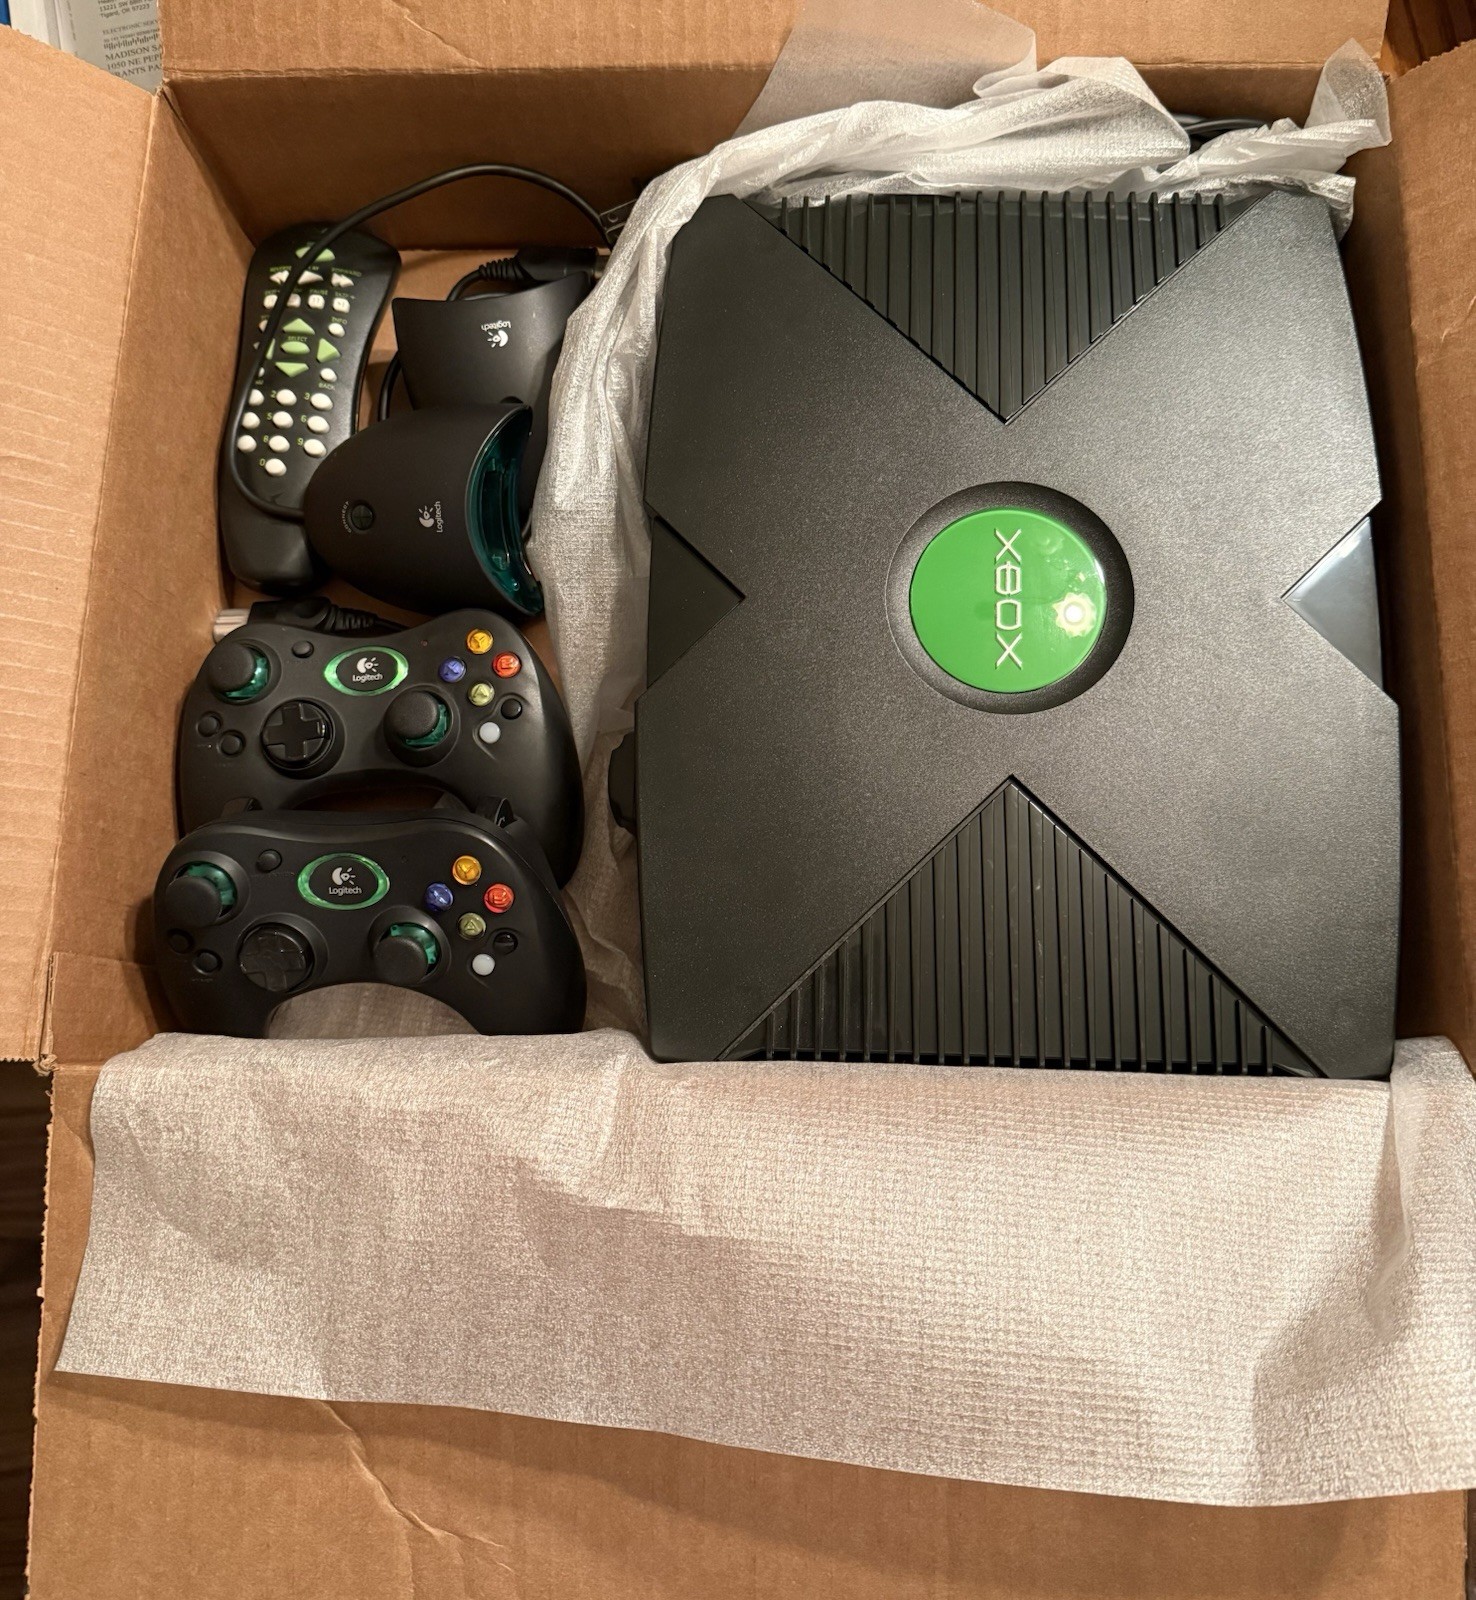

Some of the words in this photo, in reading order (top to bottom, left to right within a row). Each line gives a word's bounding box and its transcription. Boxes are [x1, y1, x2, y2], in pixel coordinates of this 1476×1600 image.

[102, 22, 140, 35] ELECTRONIC
[105, 46, 150, 60] MADISON
[107, 60, 127, 70] 1050
[128, 57, 141, 66] NE
[112, 66, 147, 78] RANTS
[331, 316, 348, 325] INFO
[481, 320, 511, 331] Logitech
[318, 382, 336, 391] BACK
[270, 391, 277, 399] 2
[303, 392, 311, 400] 3
[266, 412, 273, 420] 5
[300, 414, 307, 423] 6
[263, 435, 269, 443] 8
[297, 437, 304, 446] 9
[259, 458, 266, 467] 0
[434, 501, 444, 533] Logitech
[994, 527, 1023, 671] XBOX
[352, 673, 384, 684] Logitech
[328, 886, 363, 897] Logitech
